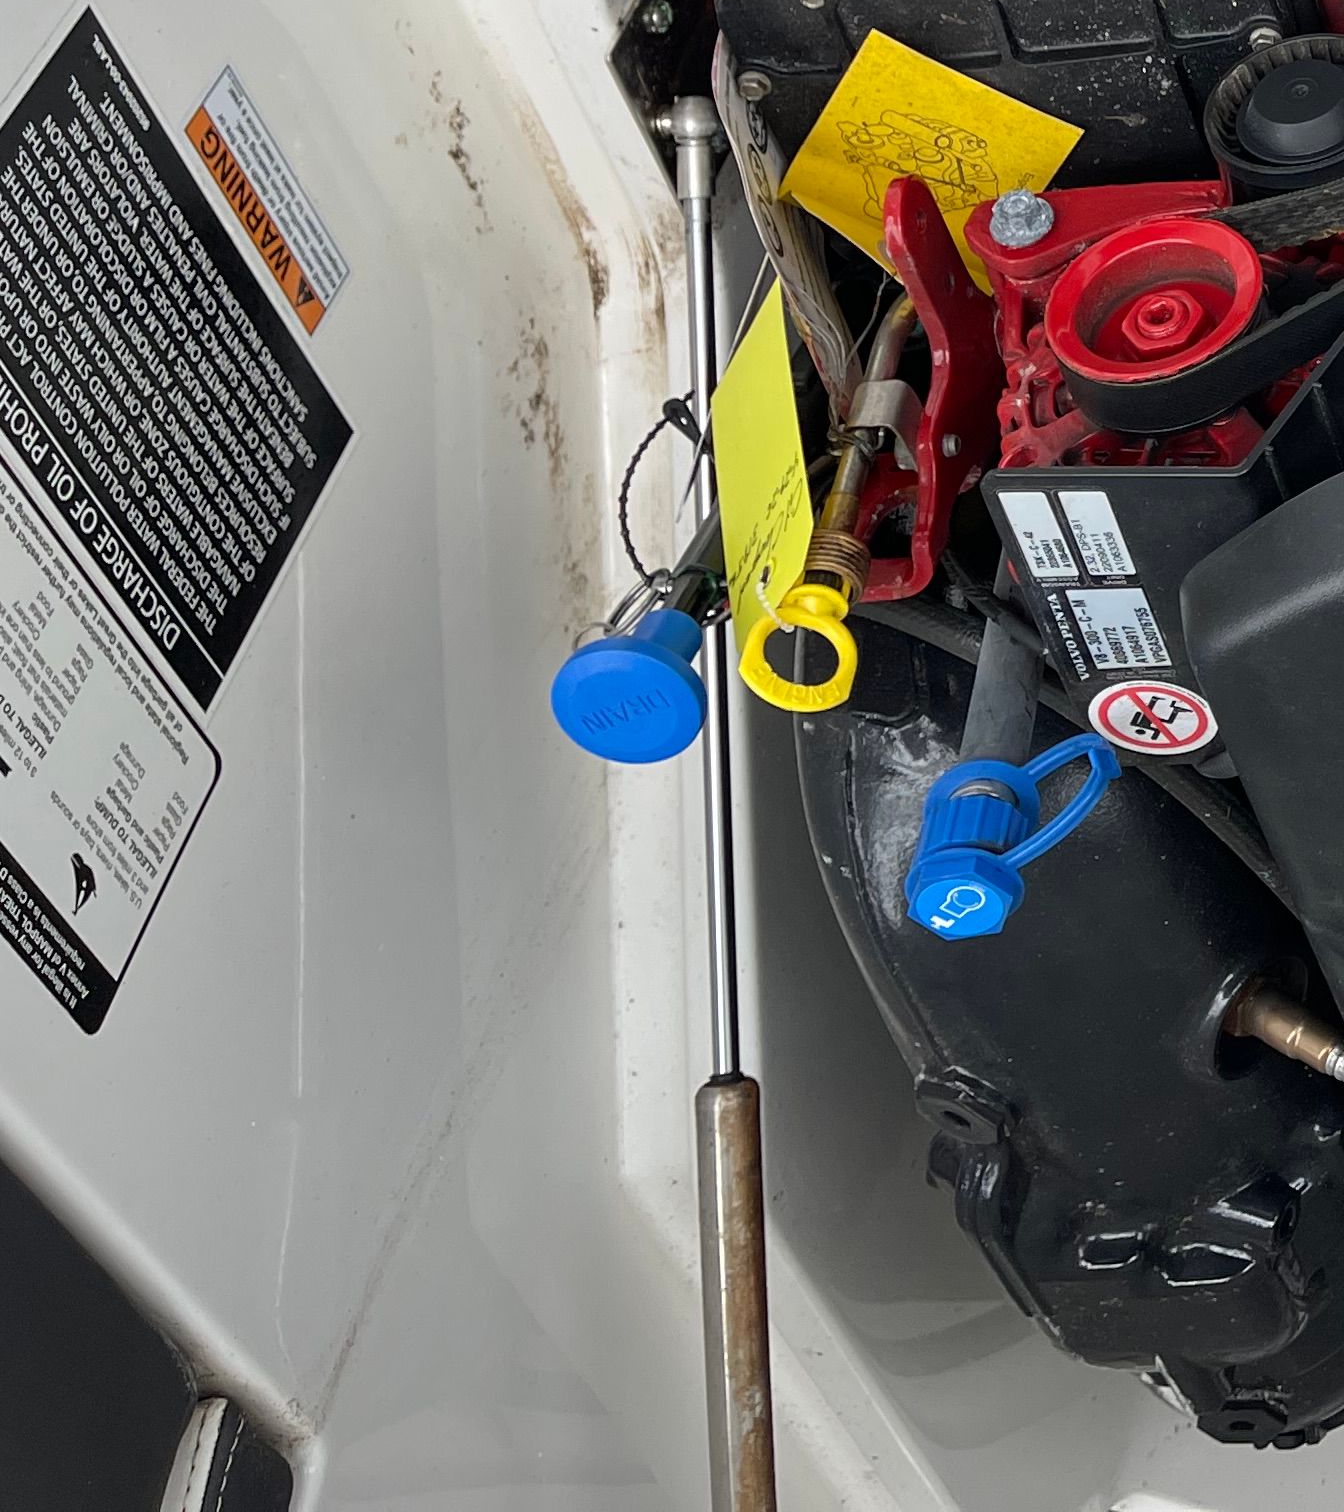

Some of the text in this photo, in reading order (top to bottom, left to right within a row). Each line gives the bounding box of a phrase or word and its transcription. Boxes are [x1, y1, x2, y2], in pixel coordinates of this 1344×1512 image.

[62, 72, 116, 156] CRIMINAL
[96, 88, 173, 210] IMPRISONMENT.
[108, 144, 152, 214] AND/OR
[197, 124, 294, 282] WARNING
[46, 198, 90, 264] UNITED
[145, 203, 197, 285] PENALTIES
[166, 199, 194, 244] AND
[187, 232, 218, 282] FINES
[82, 253, 108, 293] THE
[101, 281, 123, 315] OF
[190, 274, 218, 318] CIVIL
[116, 303, 174, 392] AUTHORITY
[212, 271, 263, 354] INCLUDING
[0, 161, 267, 566] RESOURCES BELONGING TO, APPERTAINING TO, OR UNDER THE
[212, 307, 272, 401] SUBSTANTIAL
[257, 342, 309, 425] SANCTIONS
[167, 379, 235, 483] MANAGEMENT
[265, 389, 283, 418] TO
[276, 406, 317, 472] SUBJECT
[0, 269, 229, 616] THE DISCHARGE OF OIL OR OILY WASTE INTO OR UPO
[0, 373, 182, 652] DISCHARGE OF OIL PROH
[4, 327, 219, 636] THE FEDERAL WATER POLLUTION CONTROL ACT
[228, 471, 278, 547] EXCLUSIVE
[1044, 592, 1074, 638] PENTA
[1120, 625, 1148, 663] A1064917
[1064, 639, 1090, 679] VOLVO
[2, 699, 48, 760] ILLEGAL TO
[29, 710, 55, 745] Plastic
[92, 794, 157, 880] ILLEGAL TO DUMP:
